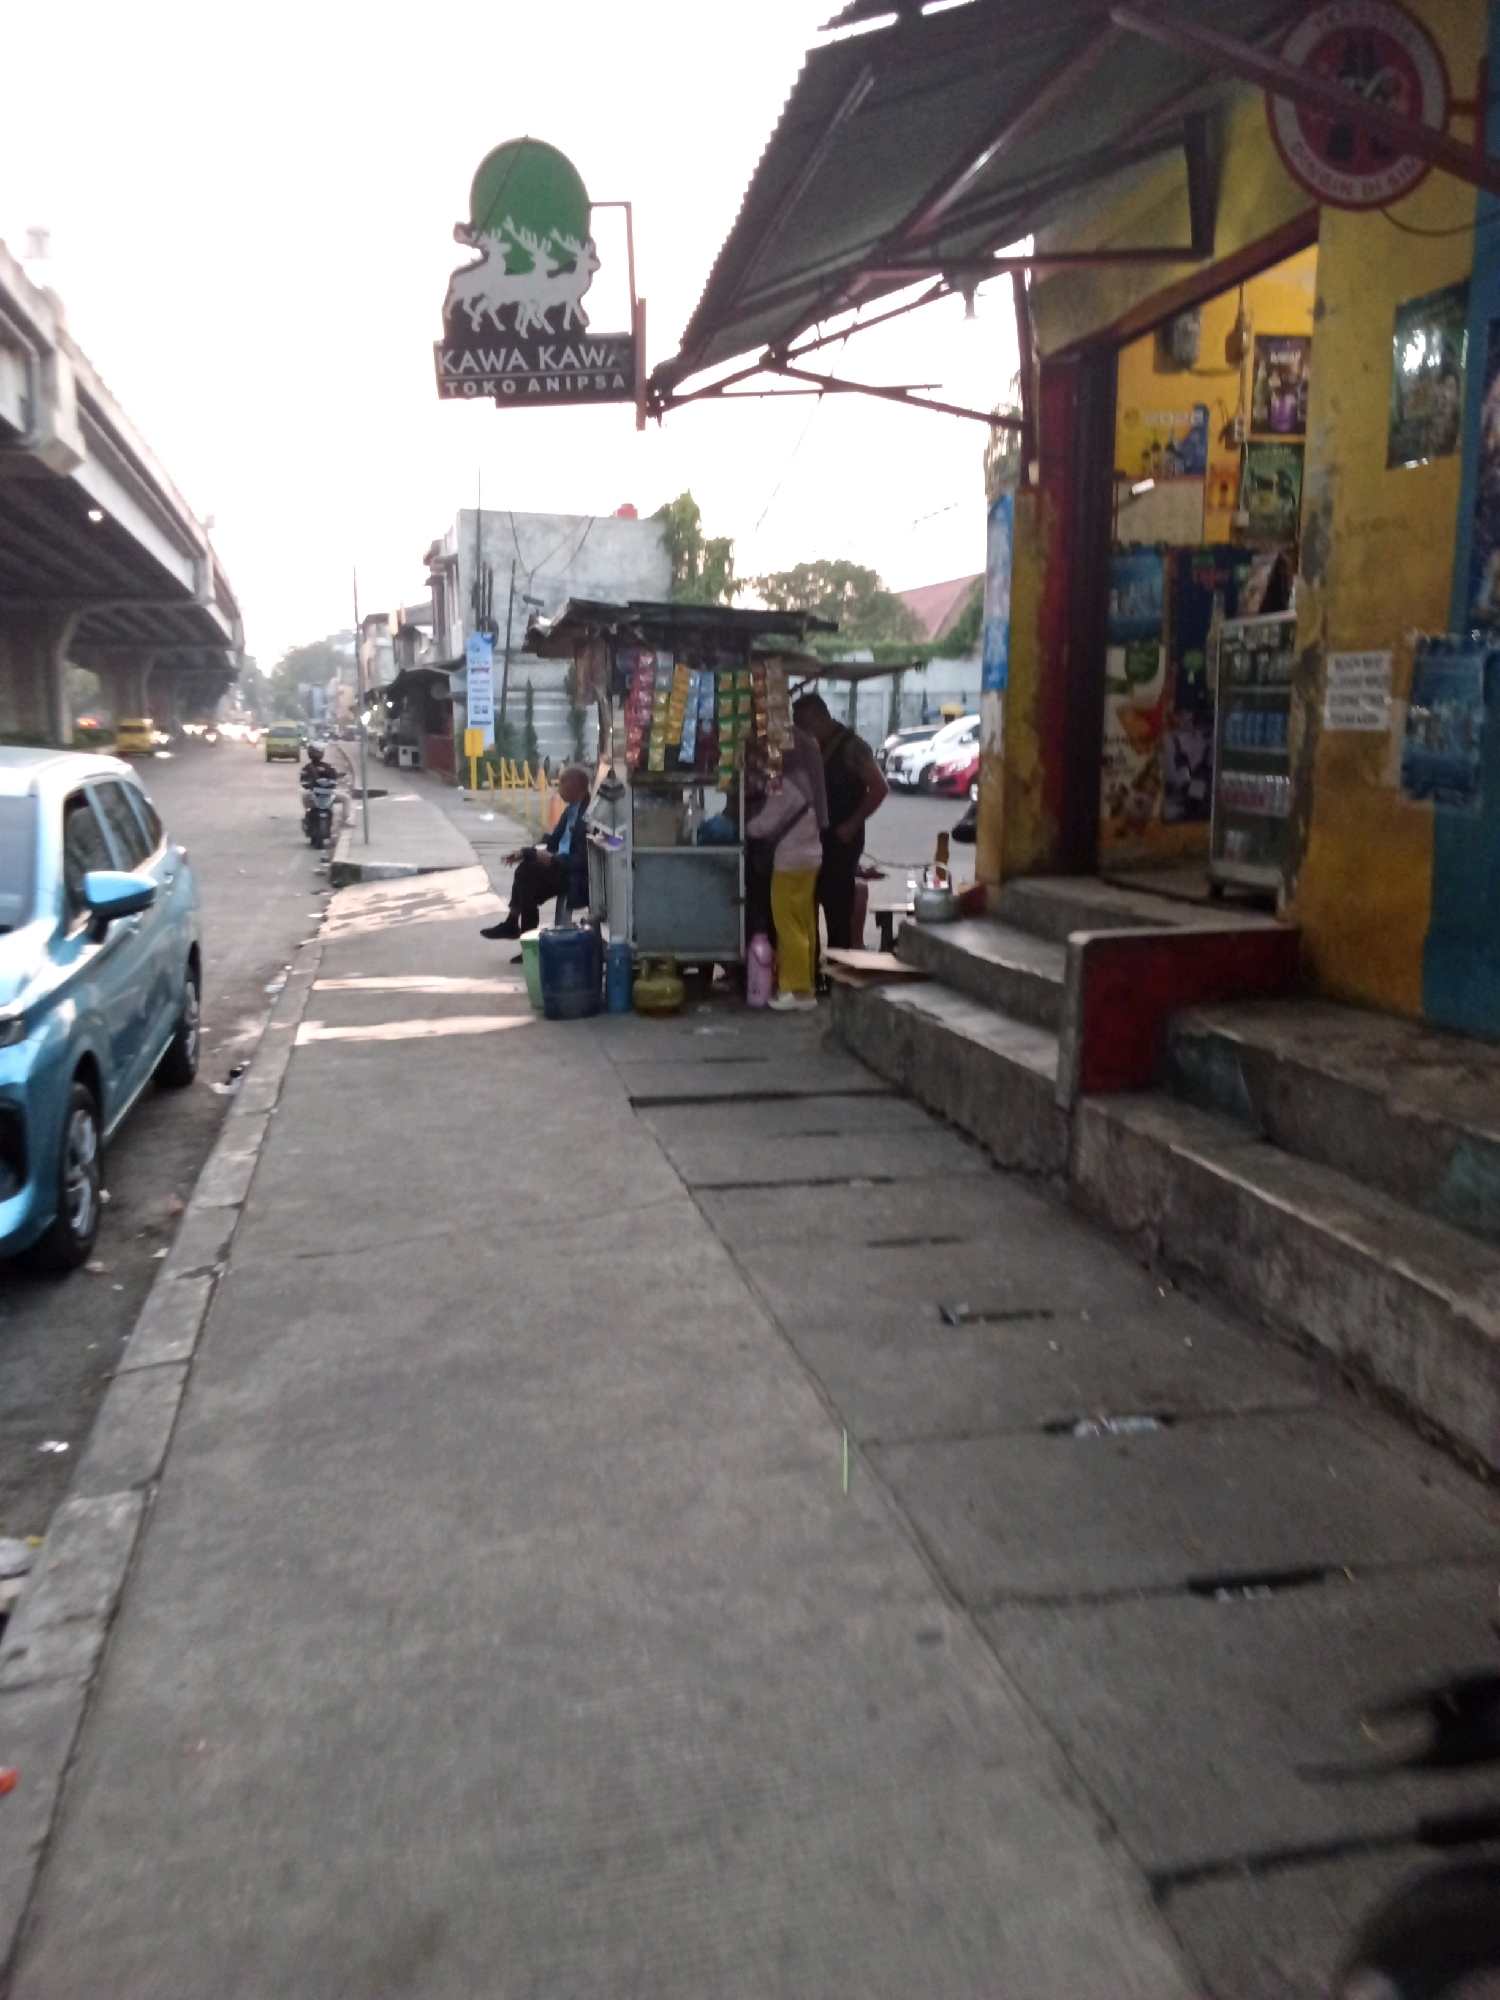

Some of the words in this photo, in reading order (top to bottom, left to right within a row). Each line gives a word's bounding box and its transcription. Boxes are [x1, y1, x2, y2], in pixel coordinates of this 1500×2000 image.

[438, 347, 529, 374] KAWA
[445, 379, 516, 396] TOKO
[528, 373, 625, 393] ANIPSA
